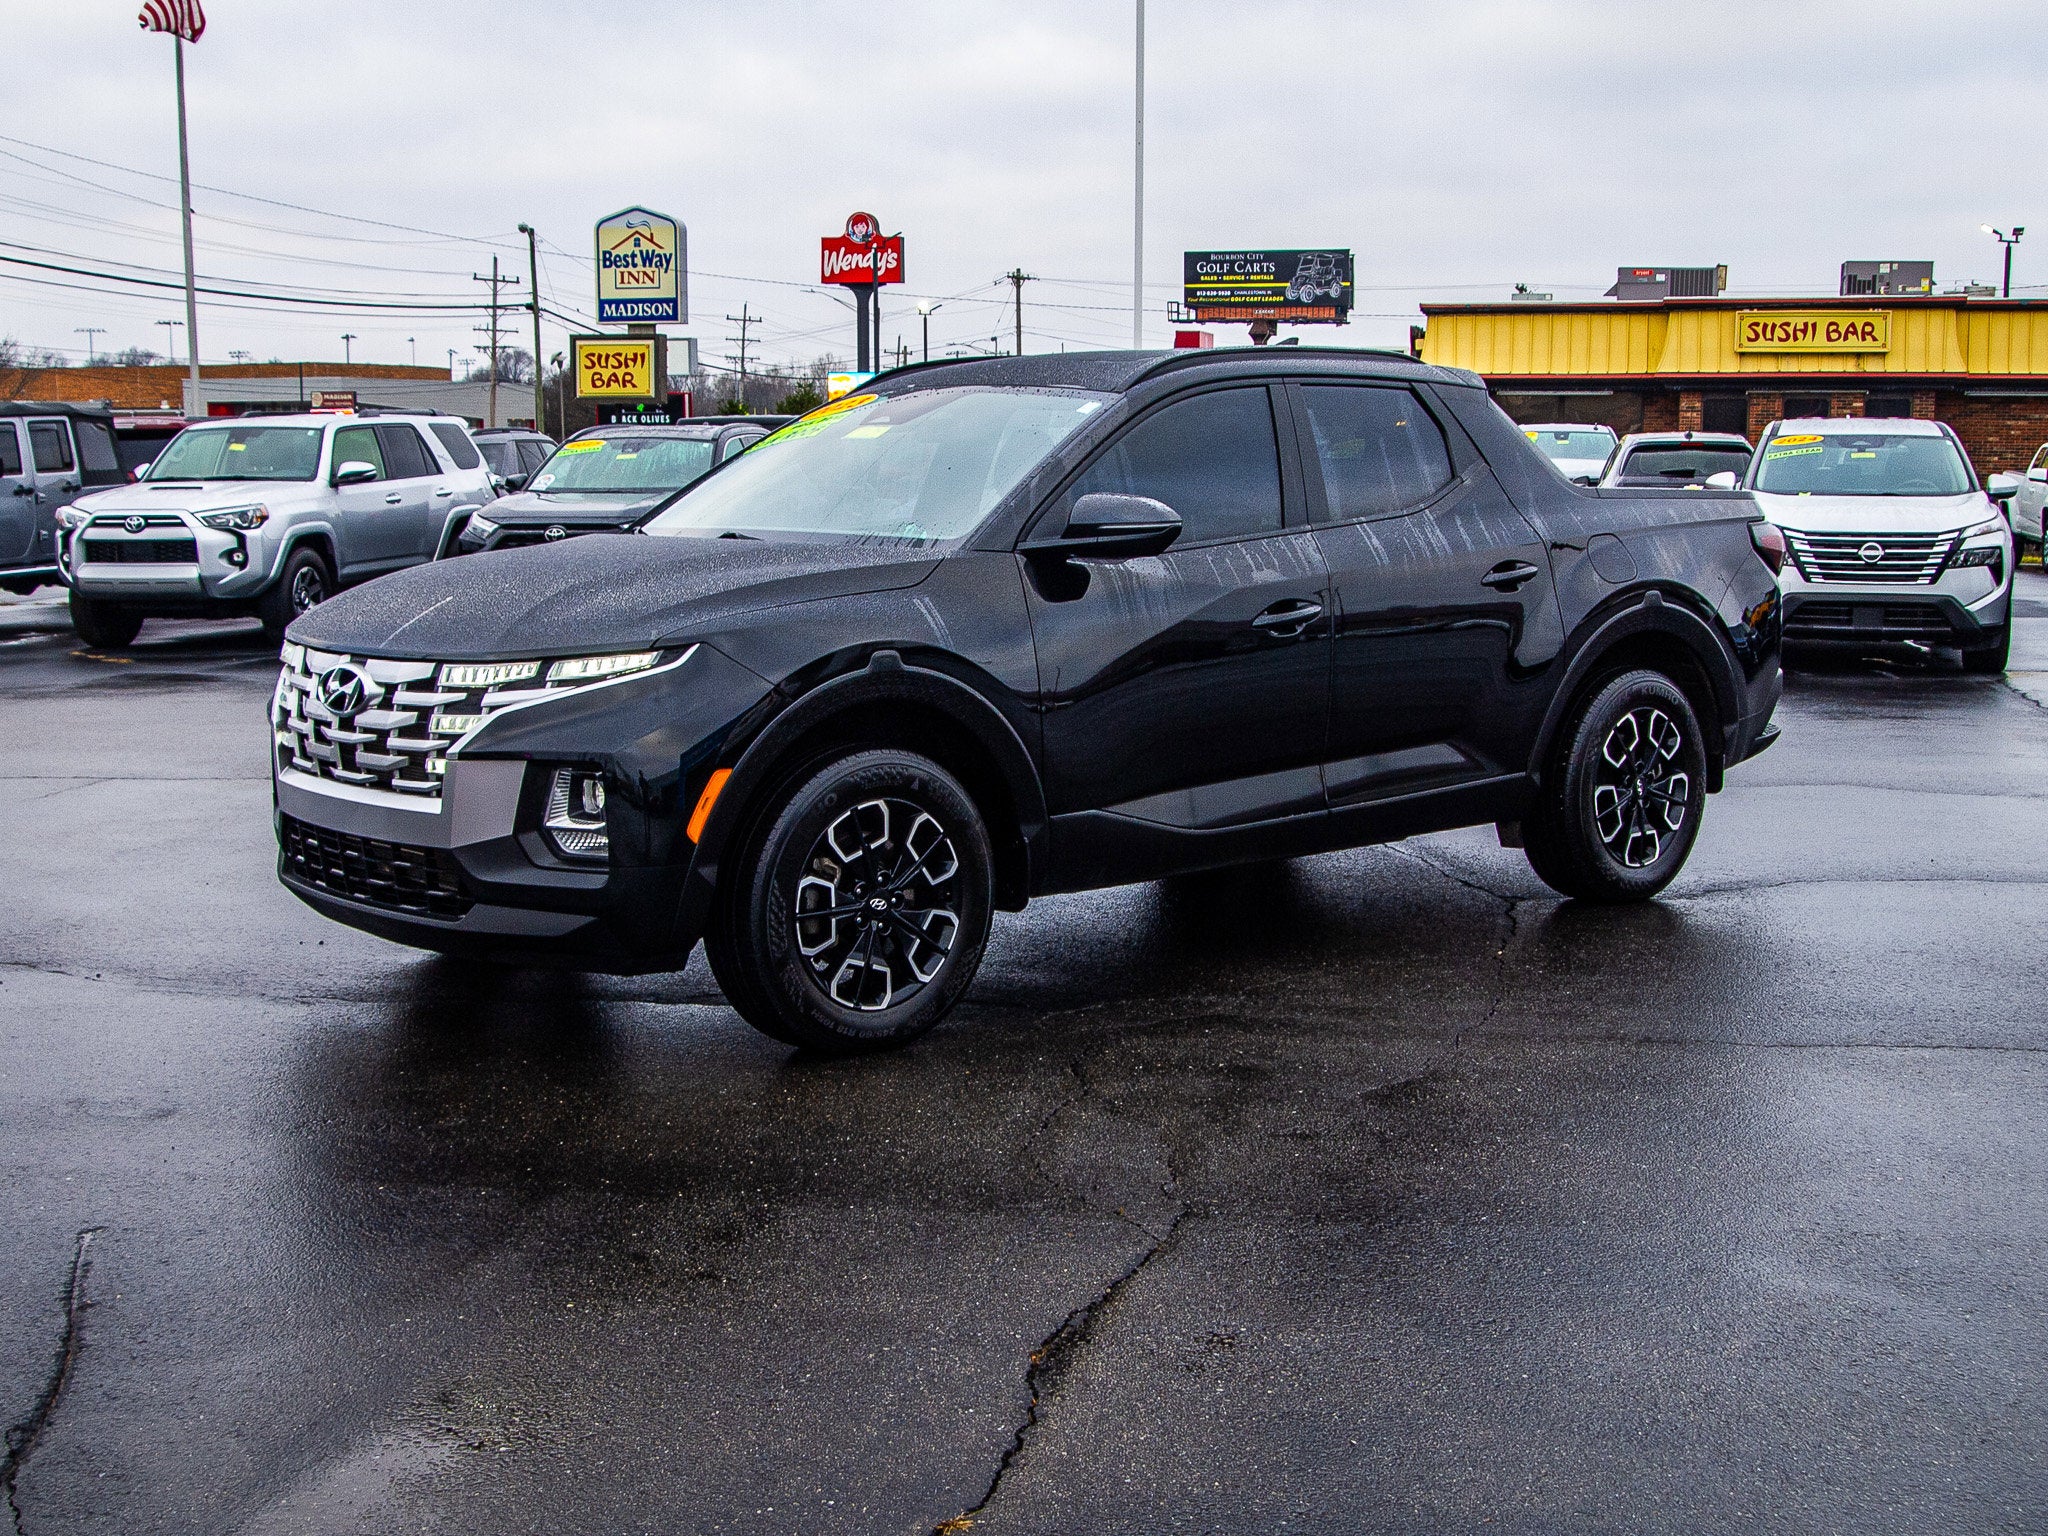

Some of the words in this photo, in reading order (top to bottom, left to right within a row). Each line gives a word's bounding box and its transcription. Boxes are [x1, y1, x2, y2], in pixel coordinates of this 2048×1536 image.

[602, 249, 638, 268] Best
[639, 249, 673, 273] Way
[824, 245, 898, 277] Wendy's
[1247, 252, 1265, 260] CITY
[1196, 261, 1230, 273] GOLF
[1234, 261, 1276, 273] CARTS
[619, 270, 656, 285] INN
[603, 303, 673, 317] MADISON
[1746, 321, 1817, 342] SUSHI
[1825, 321, 1879, 342] BAR
[584, 352, 646, 369] SUSHI
[591, 371, 638, 389] BAR
[640, 415, 670, 423] OLIVES
[1768, 451, 1794, 459] EXTRA
[1796, 447, 1822, 455] CLEAN
